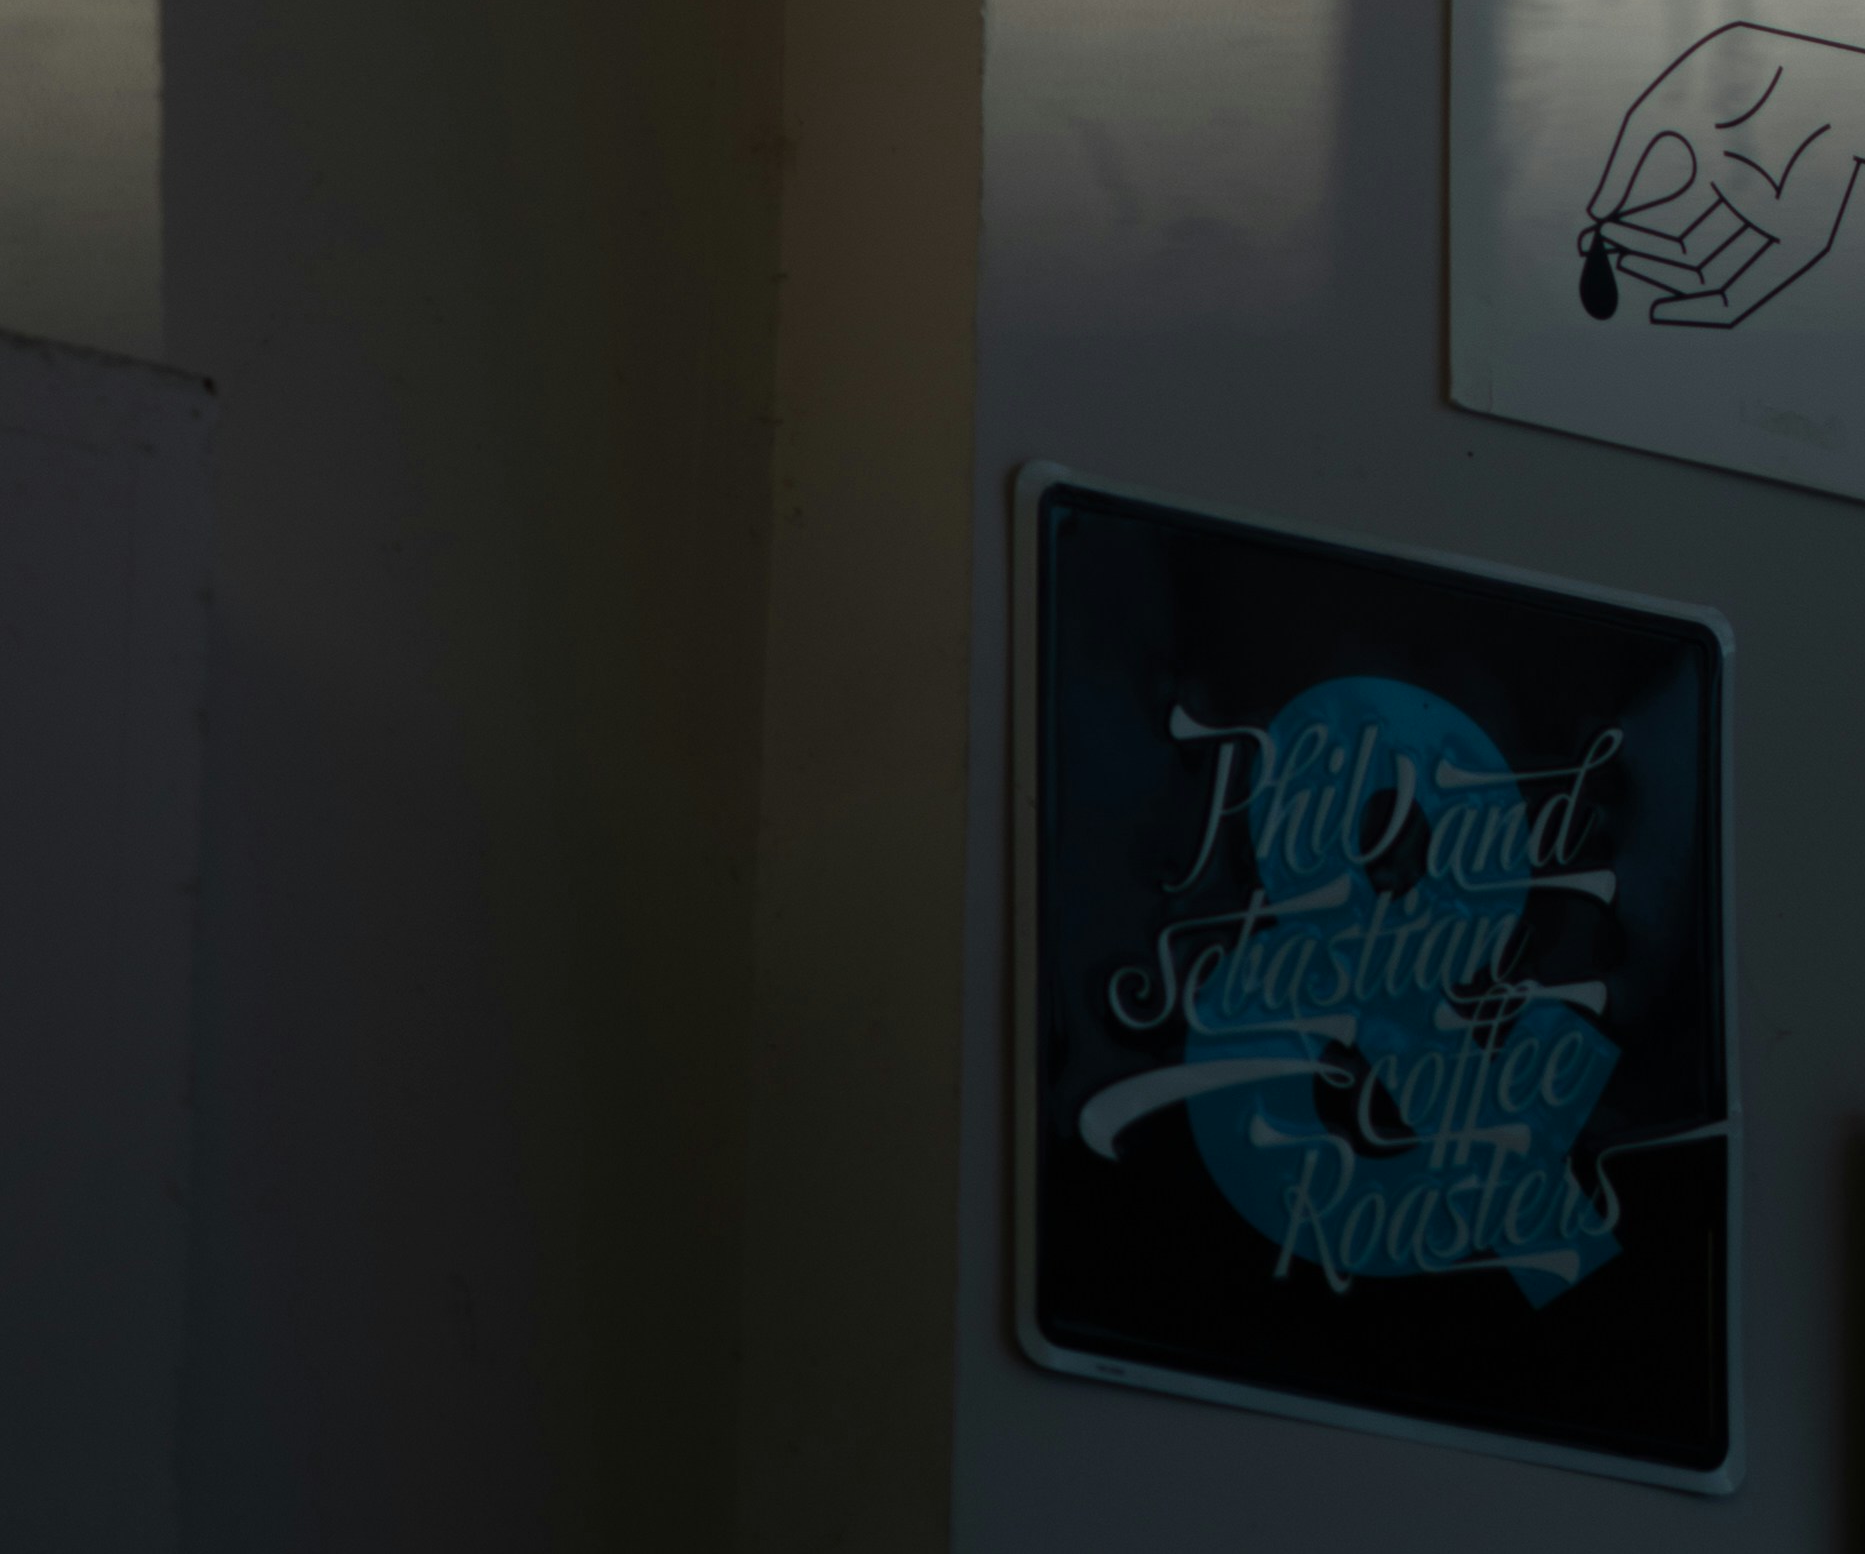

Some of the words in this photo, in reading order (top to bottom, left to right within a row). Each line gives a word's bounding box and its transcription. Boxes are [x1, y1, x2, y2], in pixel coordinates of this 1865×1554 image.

[1163, 705, 1418, 893] Phil
[1426, 727, 1624, 906] and
[1108, 873, 1607, 1049] Sebastian
[1358, 978, 1585, 1168] coffee
[1250, 1114, 1623, 1294] Roasters
